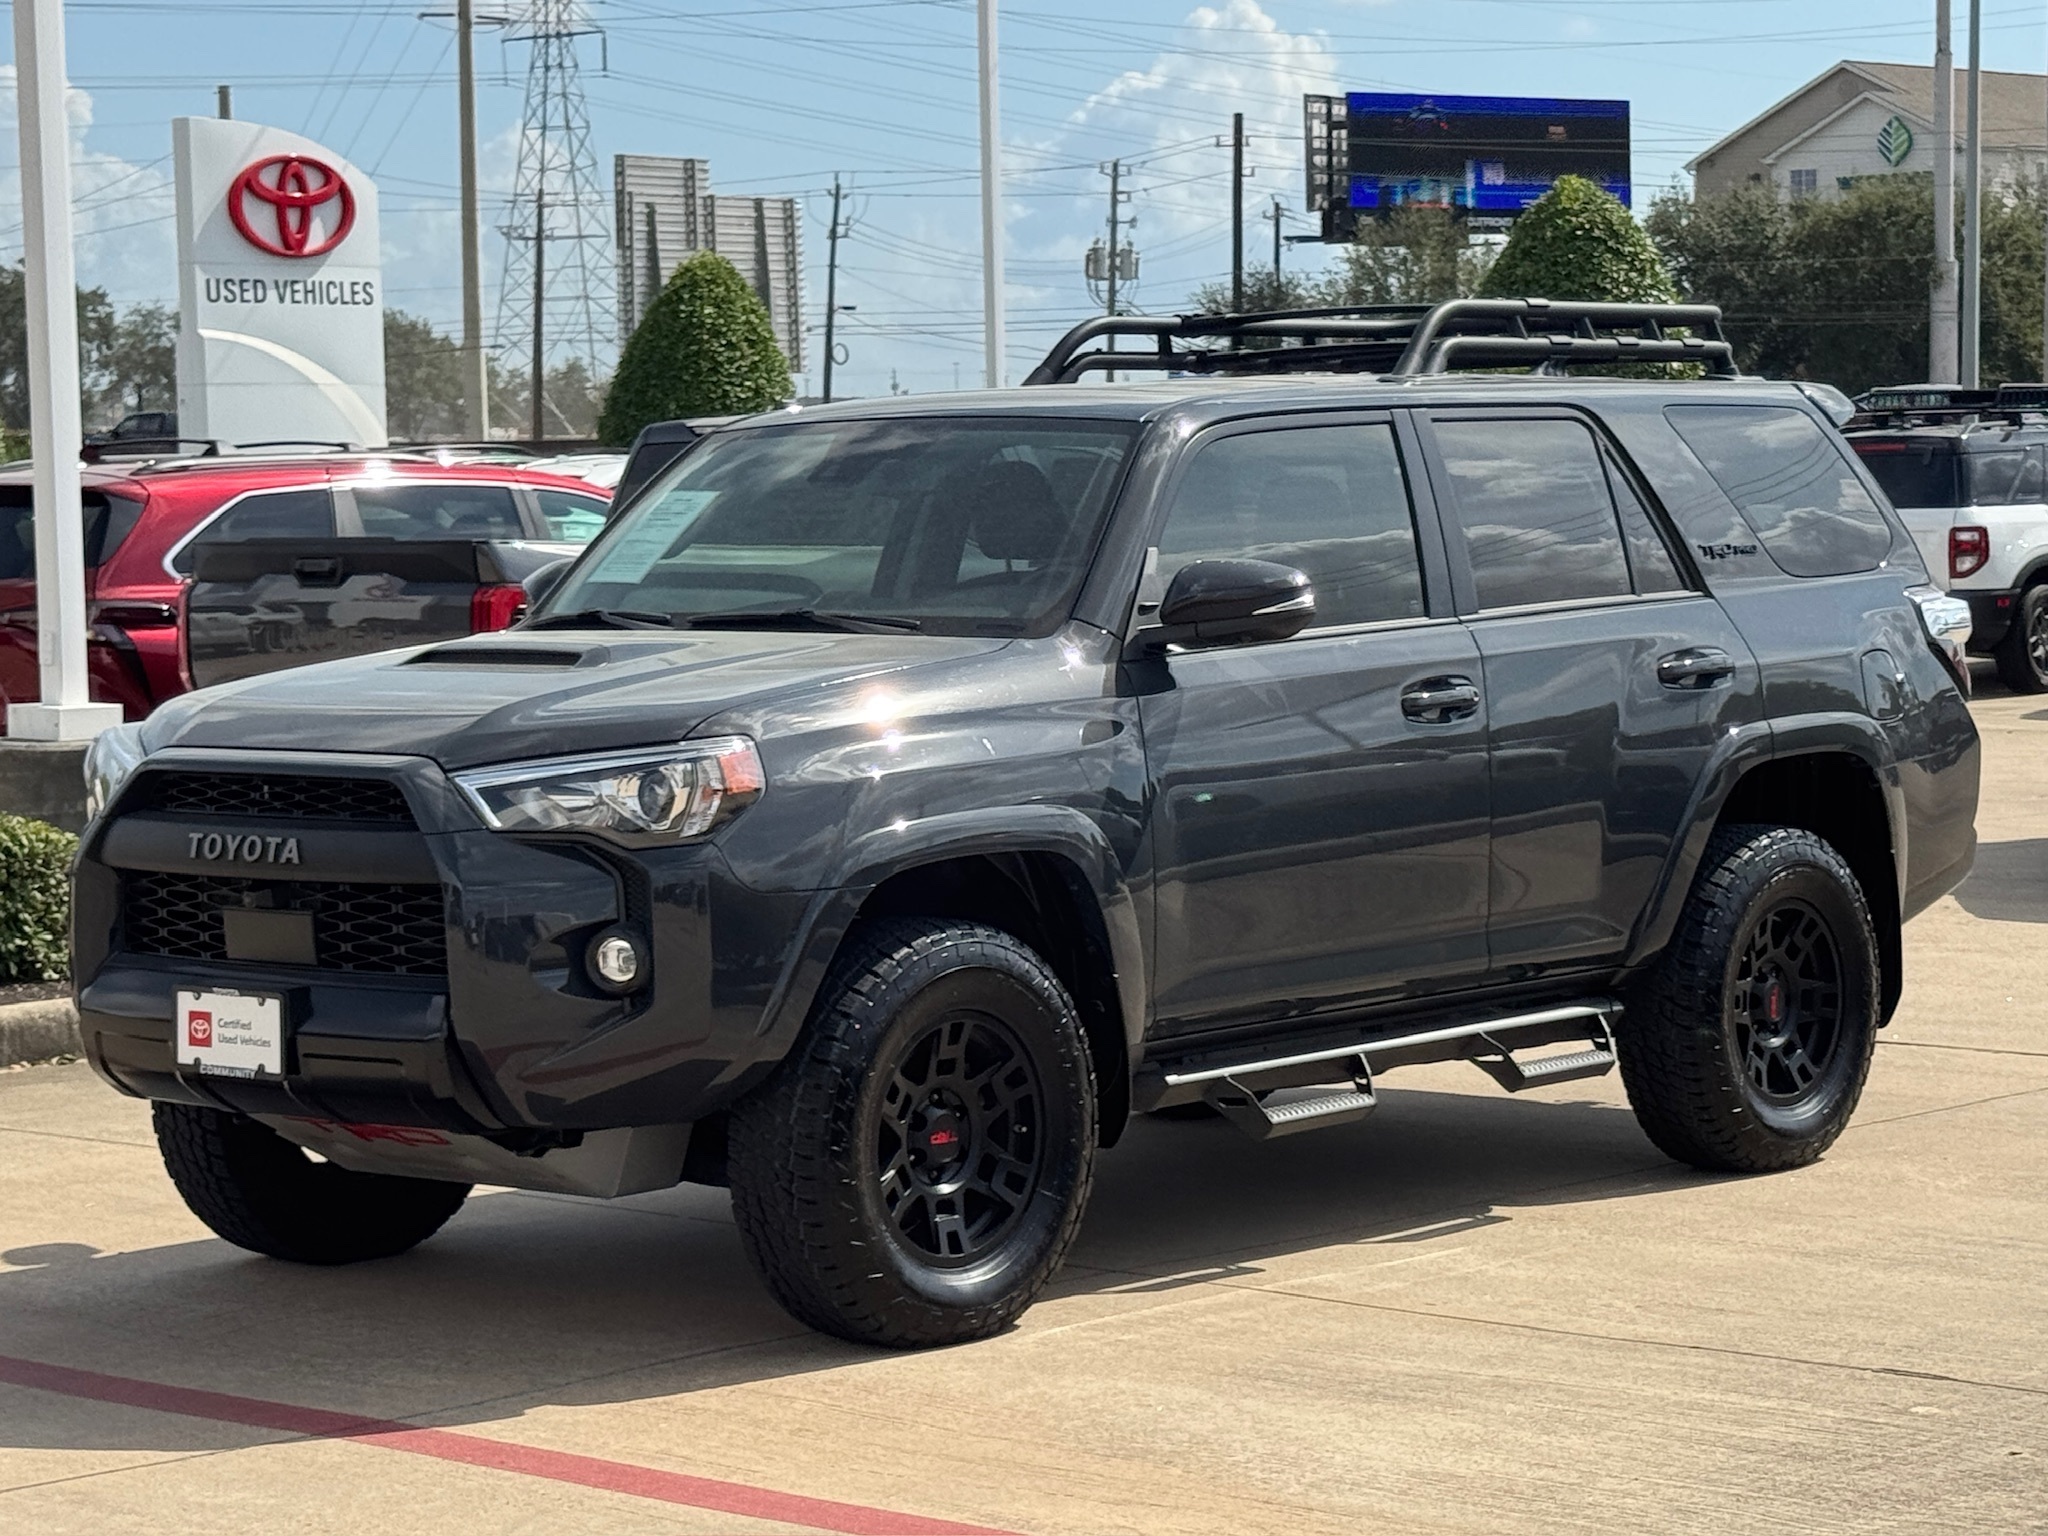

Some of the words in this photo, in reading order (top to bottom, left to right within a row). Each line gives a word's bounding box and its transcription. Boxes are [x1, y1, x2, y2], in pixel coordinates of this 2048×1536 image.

[206, 278, 267, 303] USED
[274, 279, 374, 305] VEHICLES
[188, 832, 300, 865] TOYOTA
[217, 1018, 252, 1031] Certified
[218, 1034, 239, 1045] Used
[240, 1036, 272, 1048] Vehicles
[200, 1065, 256, 1080] COMMUNITY
